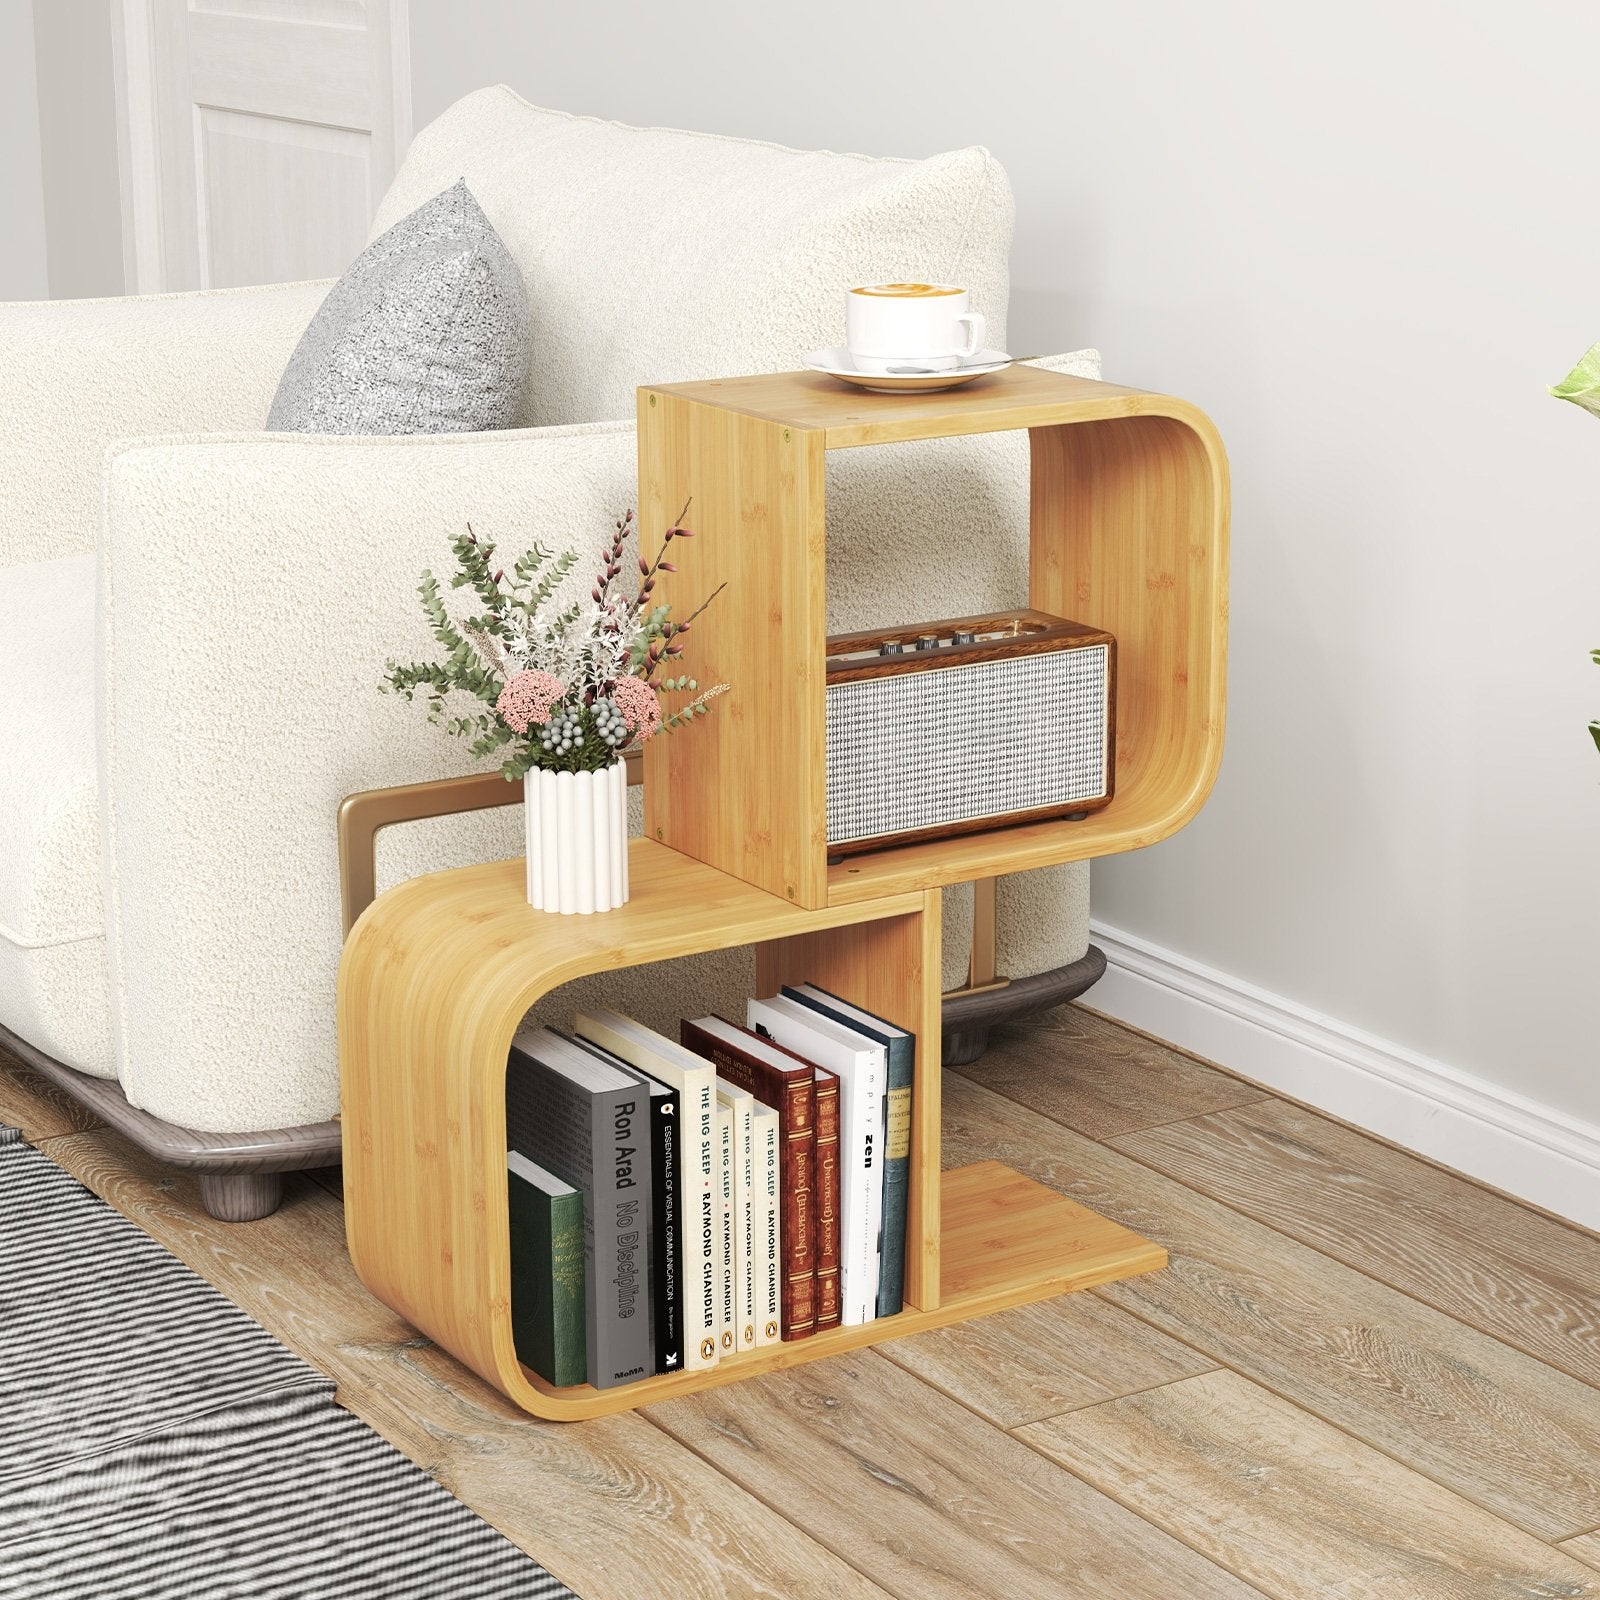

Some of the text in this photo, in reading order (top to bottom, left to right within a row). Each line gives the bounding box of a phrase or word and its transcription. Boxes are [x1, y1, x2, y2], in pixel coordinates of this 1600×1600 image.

[866, 1050, 875, 1123] simply
[767, 1149, 775, 1167] BIG
[795, 1152, 810, 1194] JOURNEY
[865, 1134, 873, 1169] zen
[701, 1085, 713, 1329] THE BIG SLEEP RAYMOND CHANDLER
[767, 1170, 775, 1197] SLEEP
[612, 1101, 640, 1319] Ron Arad No Discipline
[664, 1125, 674, 1301] ESSENTIALS OF VISUAL COMMUNICATION
[795, 1194, 808, 1257] UNEXPECTED
[723, 1212, 731, 1266] RAYMOND
[820, 1217, 834, 1256] JOURNEY
[768, 1262, 776, 1314] CHANDLER
[614, 1366, 645, 1380] MoMA
